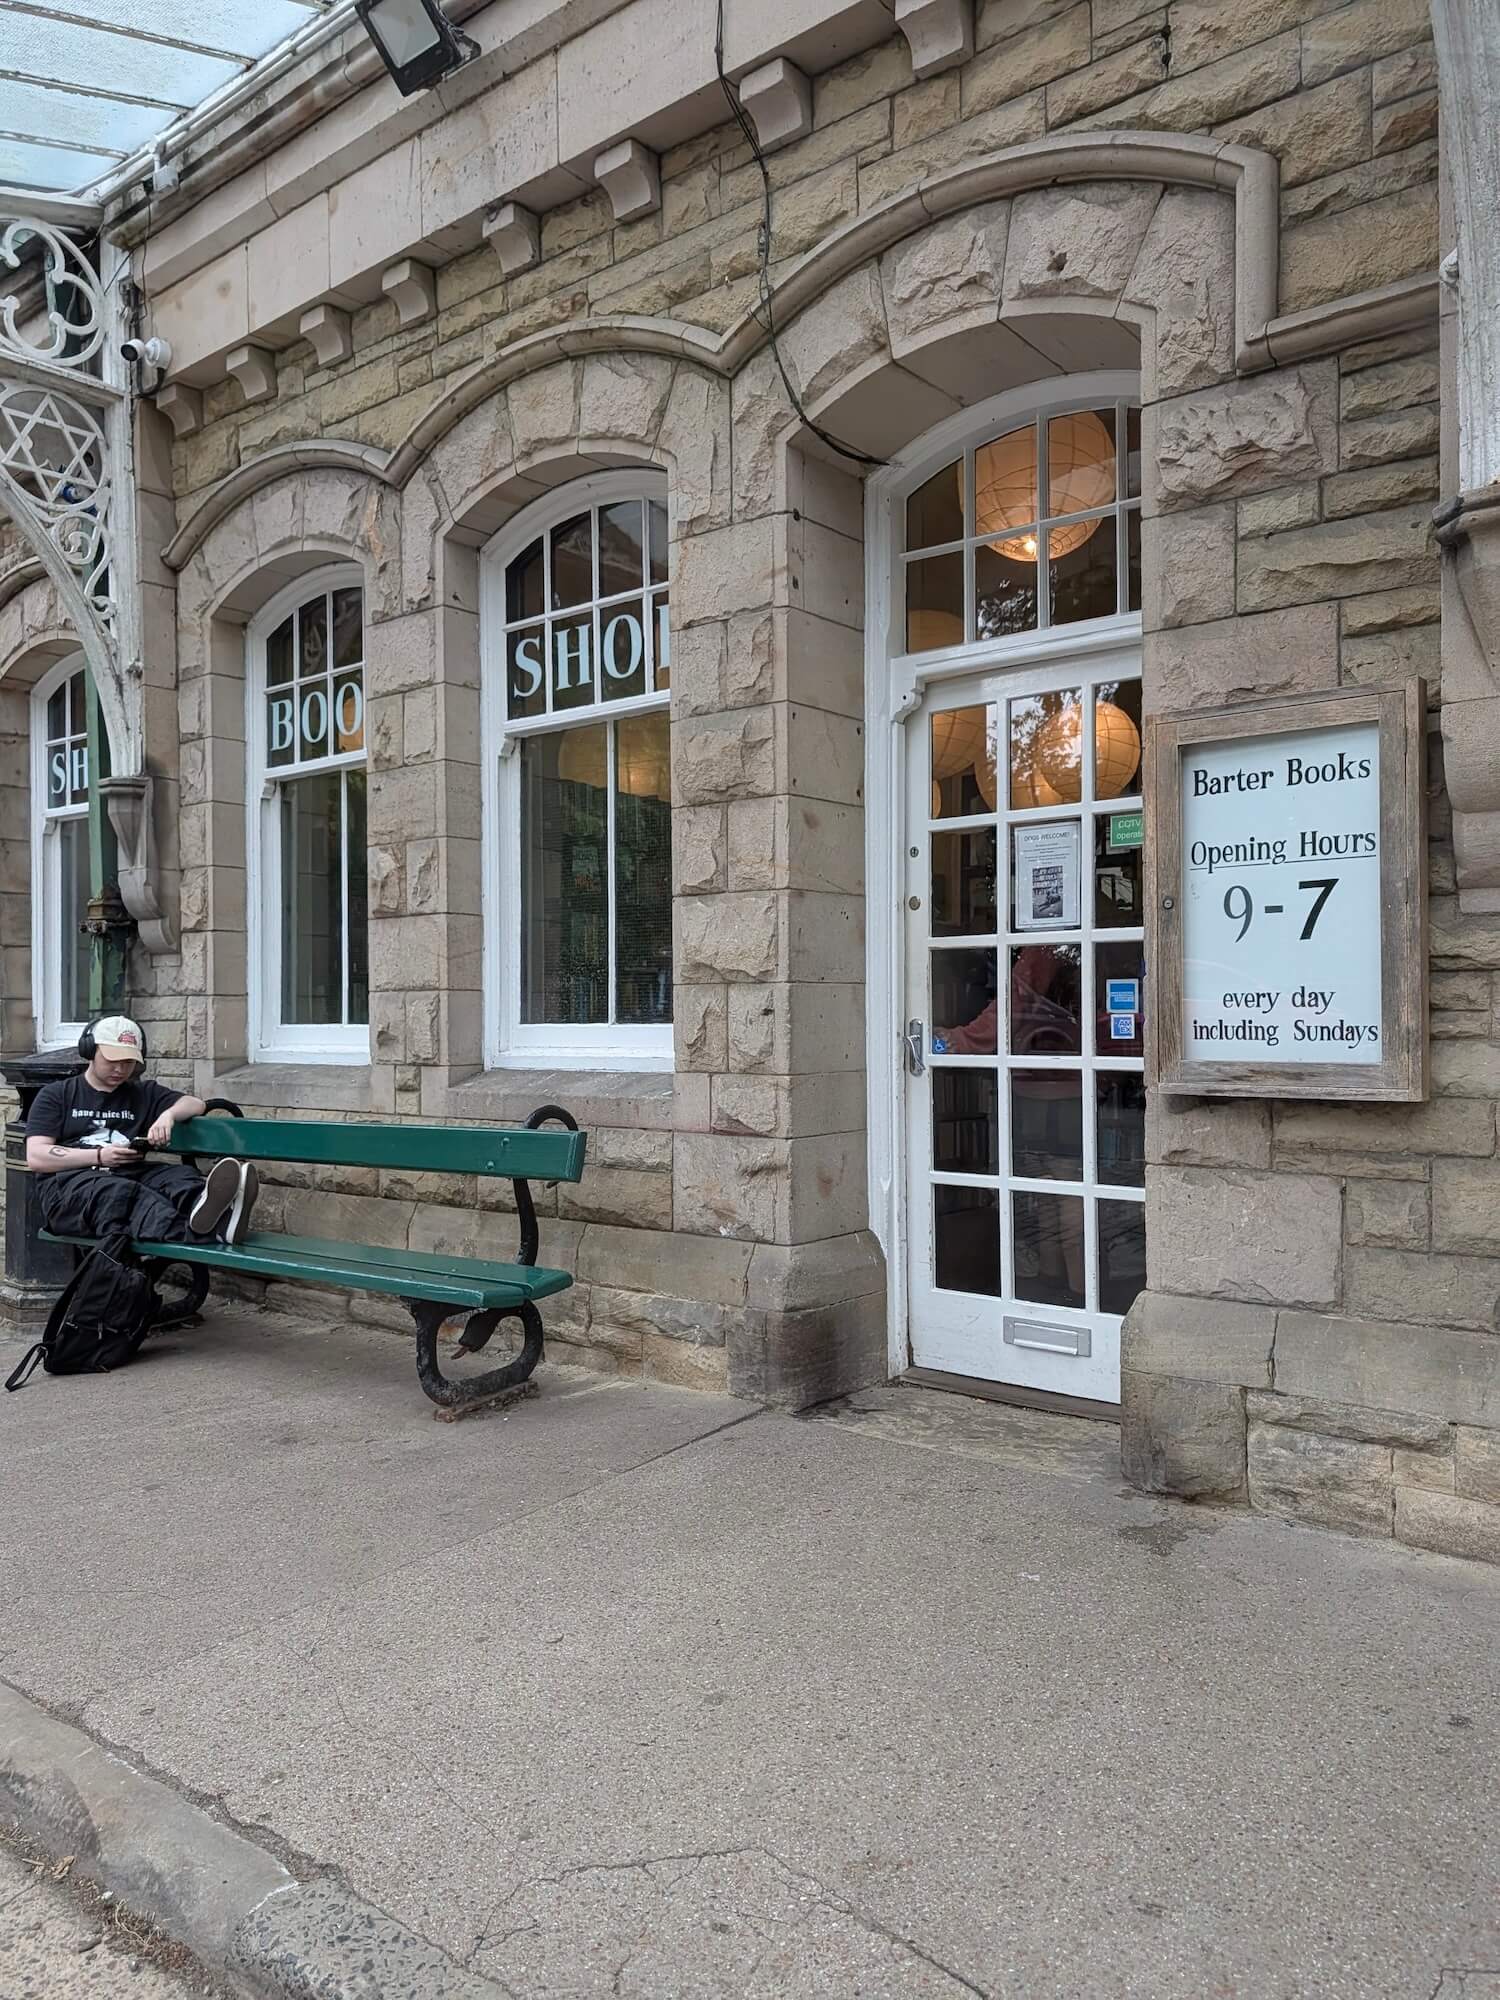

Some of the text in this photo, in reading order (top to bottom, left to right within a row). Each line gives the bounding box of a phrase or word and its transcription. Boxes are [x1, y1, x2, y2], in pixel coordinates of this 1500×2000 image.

[1193, 752, 1371, 797] Barter Books
[1191, 830, 1377, 875] Opening Hours
[1223, 878, 1340, 944] 9-7
[1222, 985, 1336, 1014] every day
[1193, 1019, 1379, 1049] including Sundays
[72, 1108, 94, 1118] have
[102, 1110, 121, 1119] nice
